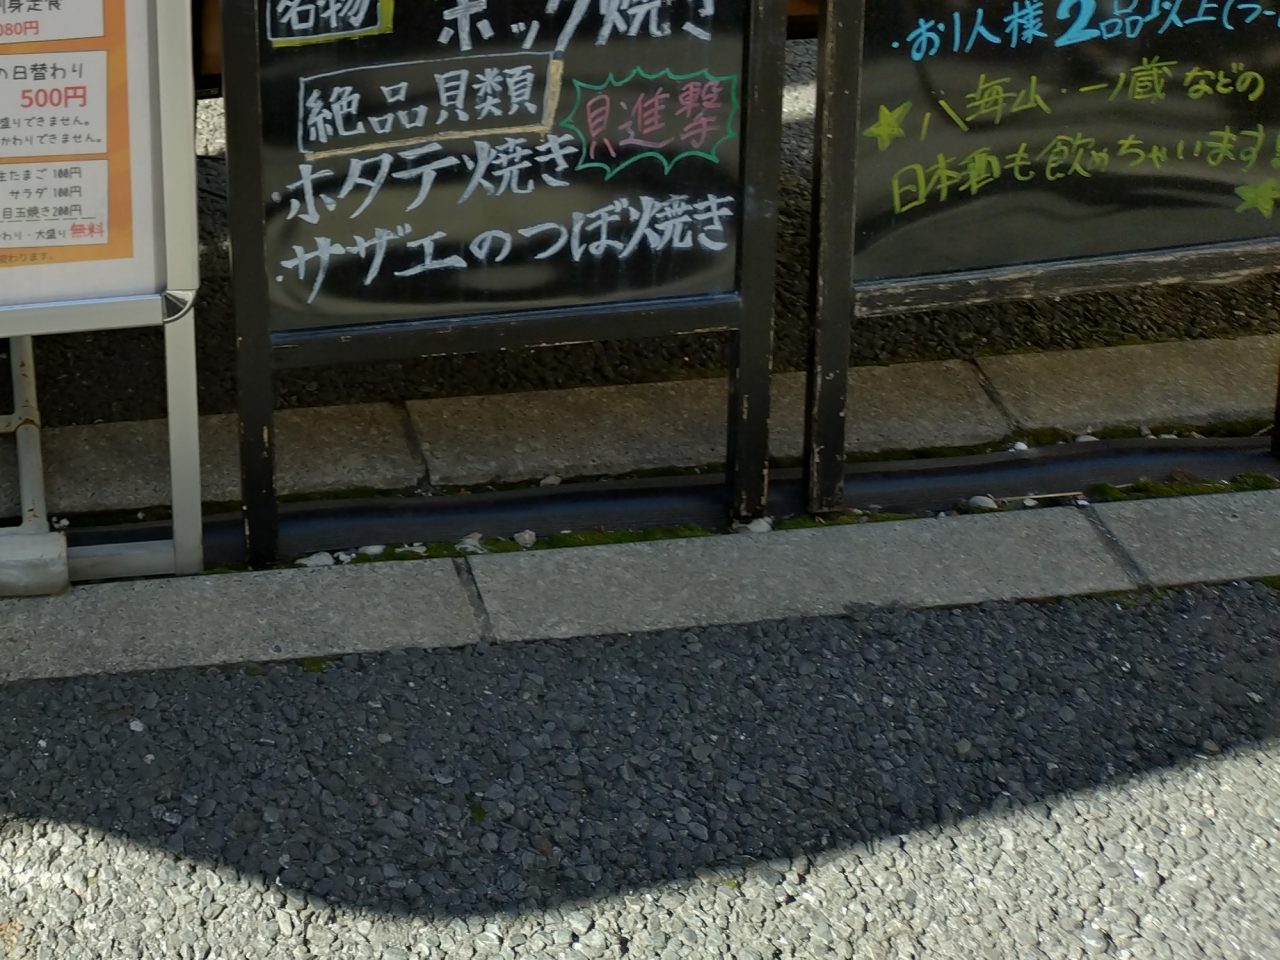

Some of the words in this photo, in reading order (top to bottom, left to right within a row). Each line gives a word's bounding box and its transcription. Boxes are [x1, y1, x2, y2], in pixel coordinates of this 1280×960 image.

[19, 85, 88, 109] 500円
[304, 63, 538, 143] 絶品貝類
[284, 133, 580, 225] ホタテ焼き
[280, 193, 735, 305] サザエのつぼ焼き
